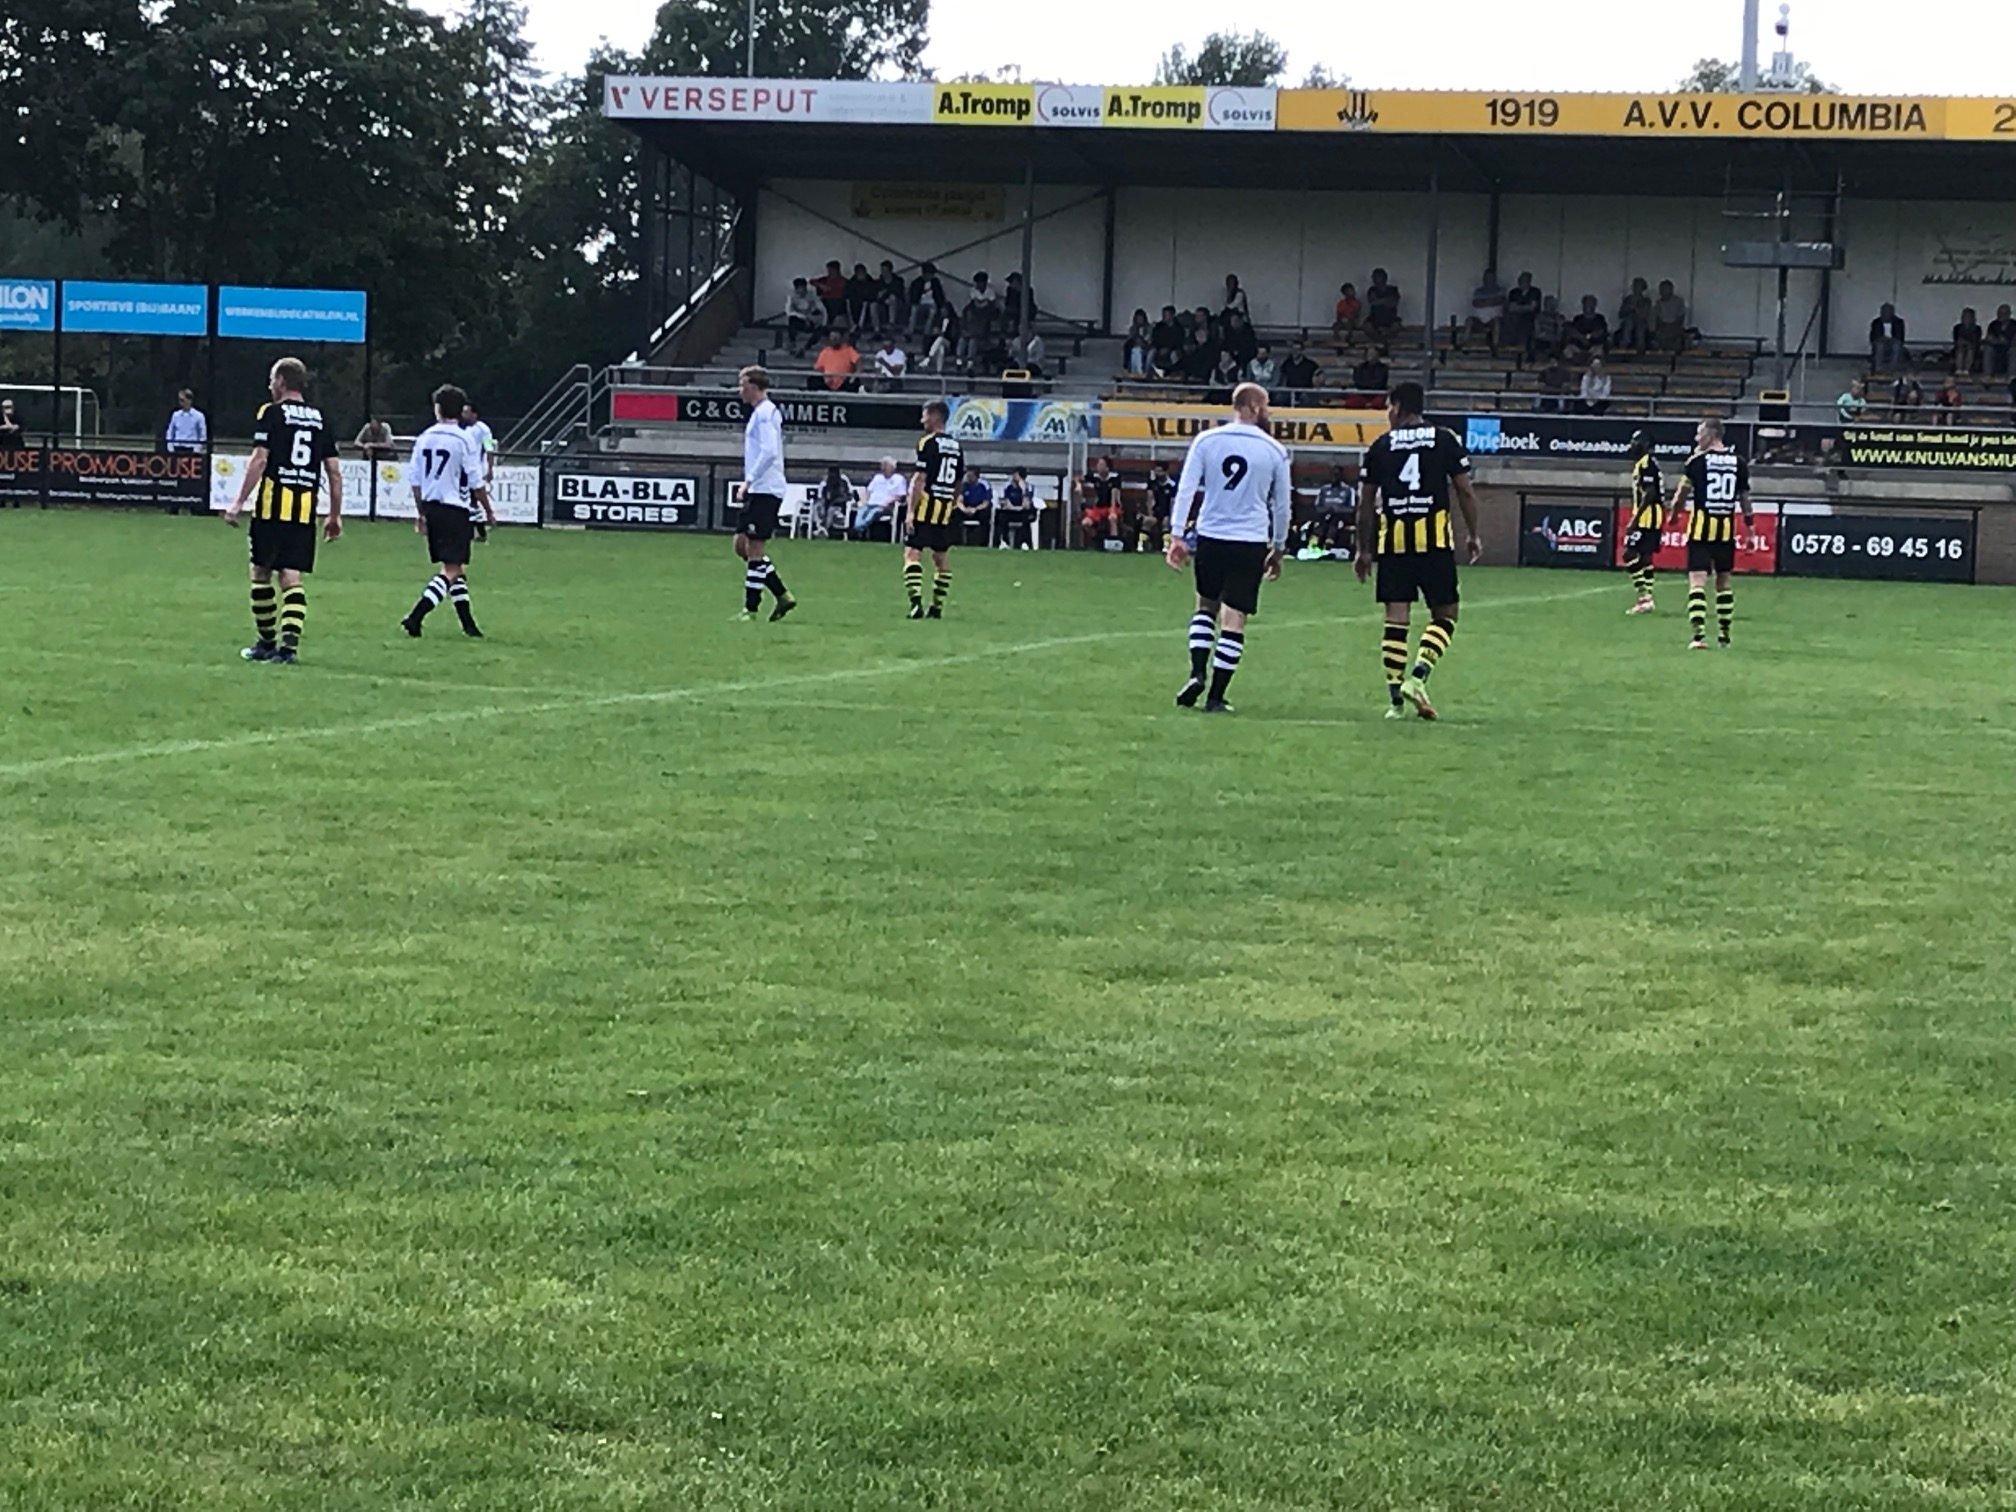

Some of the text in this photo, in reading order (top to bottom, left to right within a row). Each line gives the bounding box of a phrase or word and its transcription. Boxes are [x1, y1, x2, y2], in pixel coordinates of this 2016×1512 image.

[640, 86, 818, 114] VERSEPUT
[938, 91, 1031, 120] A.Tromp
[1051, 106, 1100, 118] SOLVIS
[1107, 95, 1201, 123] A.Tromp
[1484, 98, 1560, 127] 1919
[1222, 109, 1273, 122] SOLVIS
[1624, 101, 1926, 131] A.V.V. COLUMBIA
[0, 285, 49, 310] LON
[686, 400, 703, 418] C
[779, 404, 847, 424] MMER
[291, 430, 312, 466] 6
[1466, 432, 1540, 451] Driehoek
[50, 452, 203, 479] PROMOHOUSE
[422, 448, 451, 481] 17
[936, 456, 958, 484] 16
[1222, 454, 1249, 491] 9
[1398, 453, 1421, 491] 4
[562, 478, 691, 502] BLA-BLA
[1706, 472, 1738, 500] 20
[573, 505, 679, 523] STORES
[1557, 518, 1602, 538] ABC
[1791, 532, 1846, 555] 0578
[1866, 535, 1894, 557] 69
[1899, 537, 1928, 558] 45
[1938, 537, 1963, 559] 16
